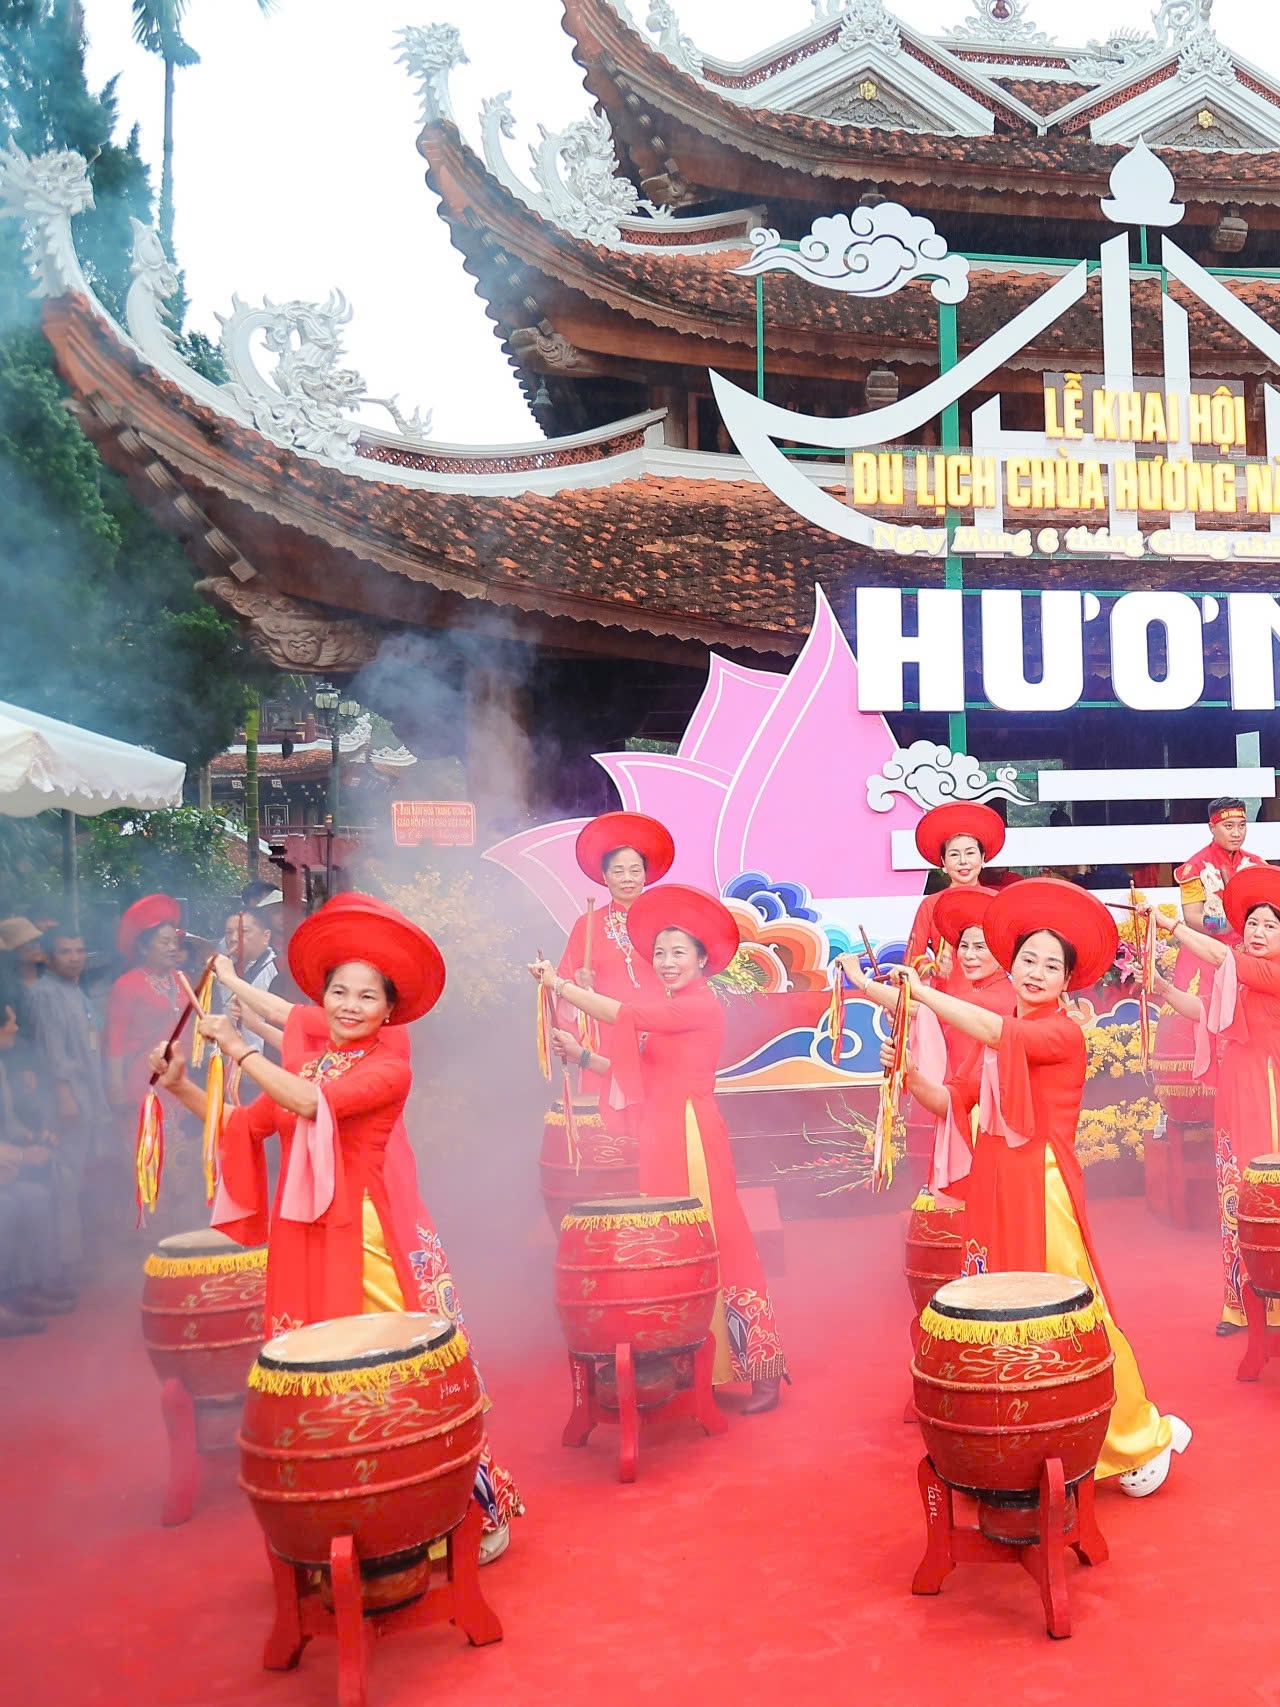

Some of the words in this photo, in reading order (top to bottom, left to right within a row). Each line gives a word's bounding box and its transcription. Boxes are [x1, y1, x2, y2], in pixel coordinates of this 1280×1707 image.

[1045, 372, 1083, 439] LỄ
[1093, 387, 1180, 443] KHAI
[1189, 386, 1246, 454] HỘI
[852, 452, 903, 506] DU
[915, 453, 996, 515] LỊCH
[1006, 446, 1105, 511] CHÙA
[1115, 457, 1236, 512] HƯƠNG
[873, 524, 946, 555] Ngày
[1037, 527, 1059, 554] 6
[1064, 525, 1145, 557] tháng
[1148, 529, 1230, 560] Giêng
